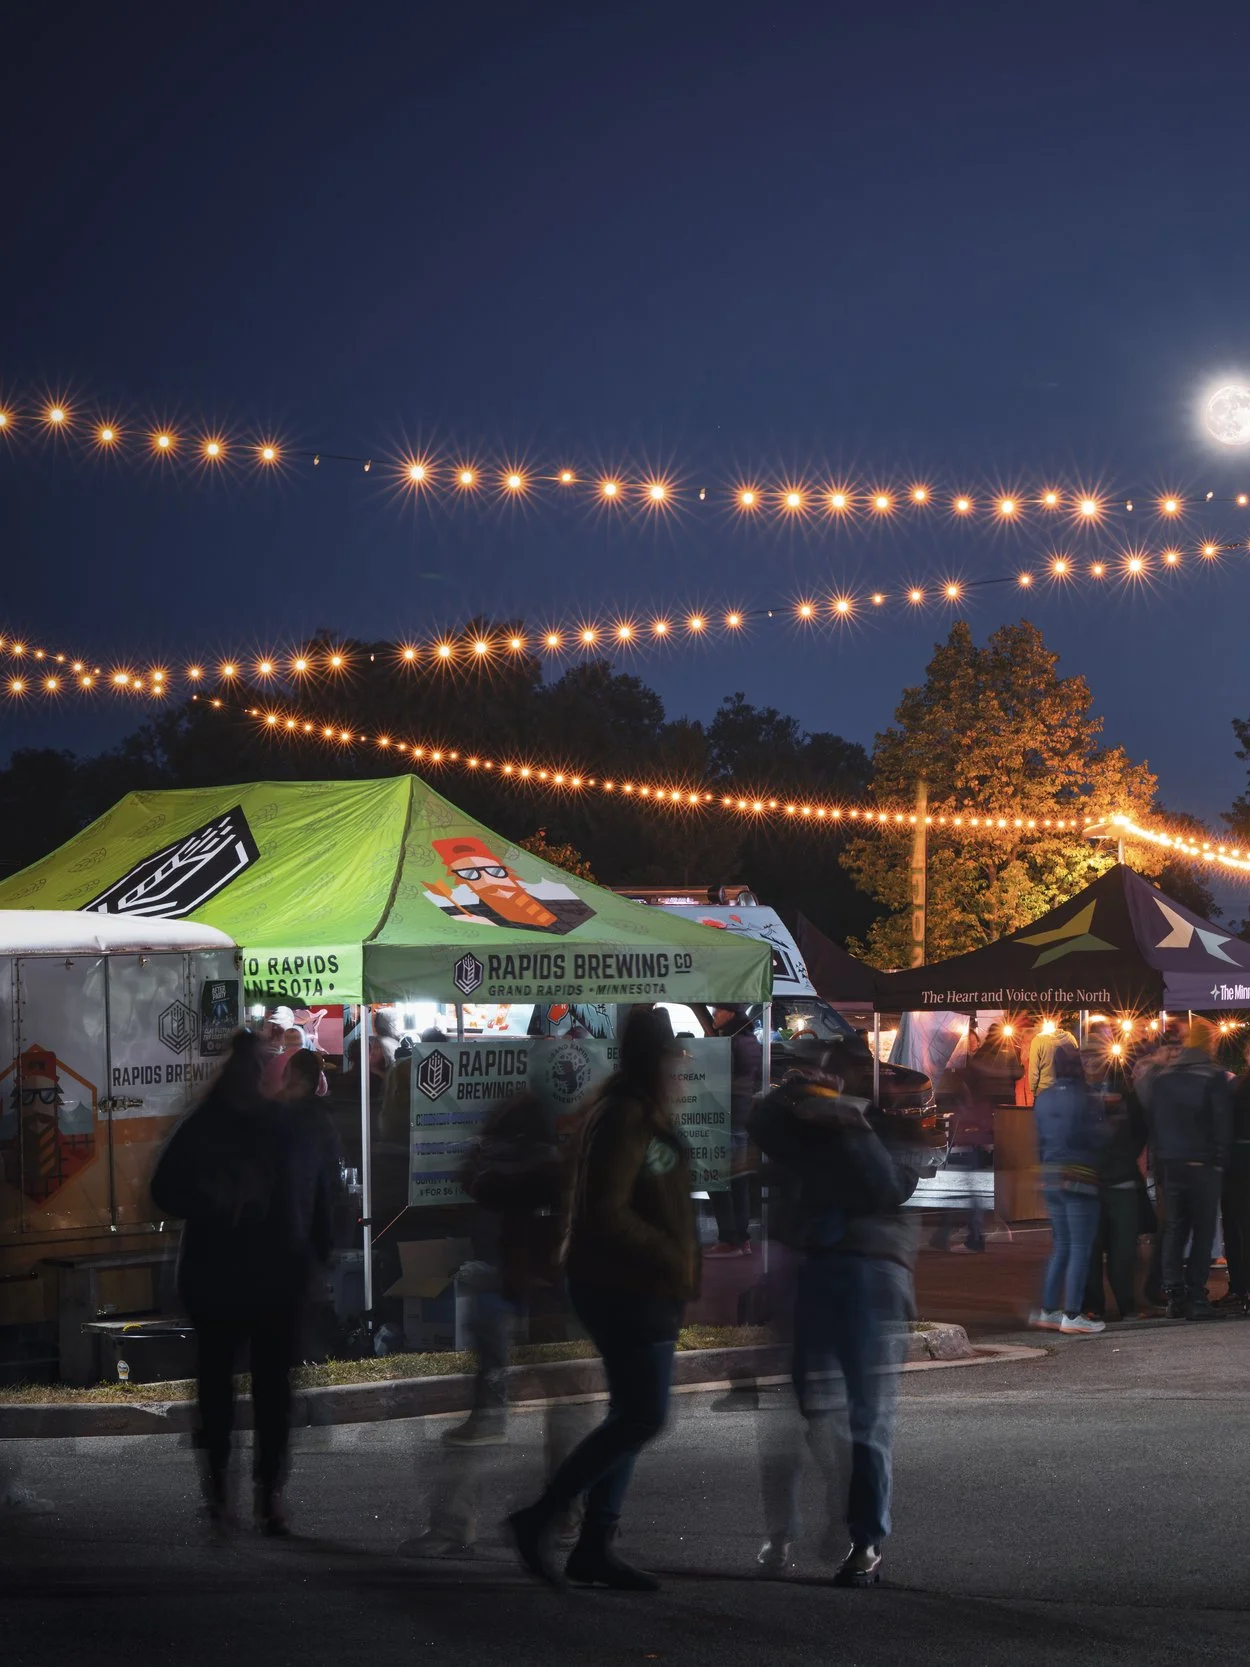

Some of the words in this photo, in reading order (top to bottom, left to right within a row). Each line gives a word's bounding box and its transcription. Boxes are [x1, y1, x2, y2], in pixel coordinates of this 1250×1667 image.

[267, 954, 339, 975] RAPIDS
[488, 954, 566, 980] RAPIDS
[574, 953, 669, 979] BREWING
[674, 953, 692, 970] CO
[488, 985, 532, 996] GRAND
[536, 984, 583, 996] RAPIDS
[595, 983, 667, 996] MINNESOTA
[922, 991, 944, 1003] The
[947, 990, 978, 1003] Heart
[981, 989, 1003, 1002] and
[1006, 988, 1037, 1002] Voice
[1040, 989, 1052, 1002] of
[1054, 988, 1074, 1002] the
[1076, 988, 1110, 1002] North
[1220, 984, 1234, 1000] The
[459, 1049, 528, 1077] RAPIDS
[112, 1065, 161, 1087] RAPIDS
[678, 1073, 706, 1081] CREAM
[457, 1082, 514, 1100] BREWING
[425, 1188, 442, 1196] FOR
